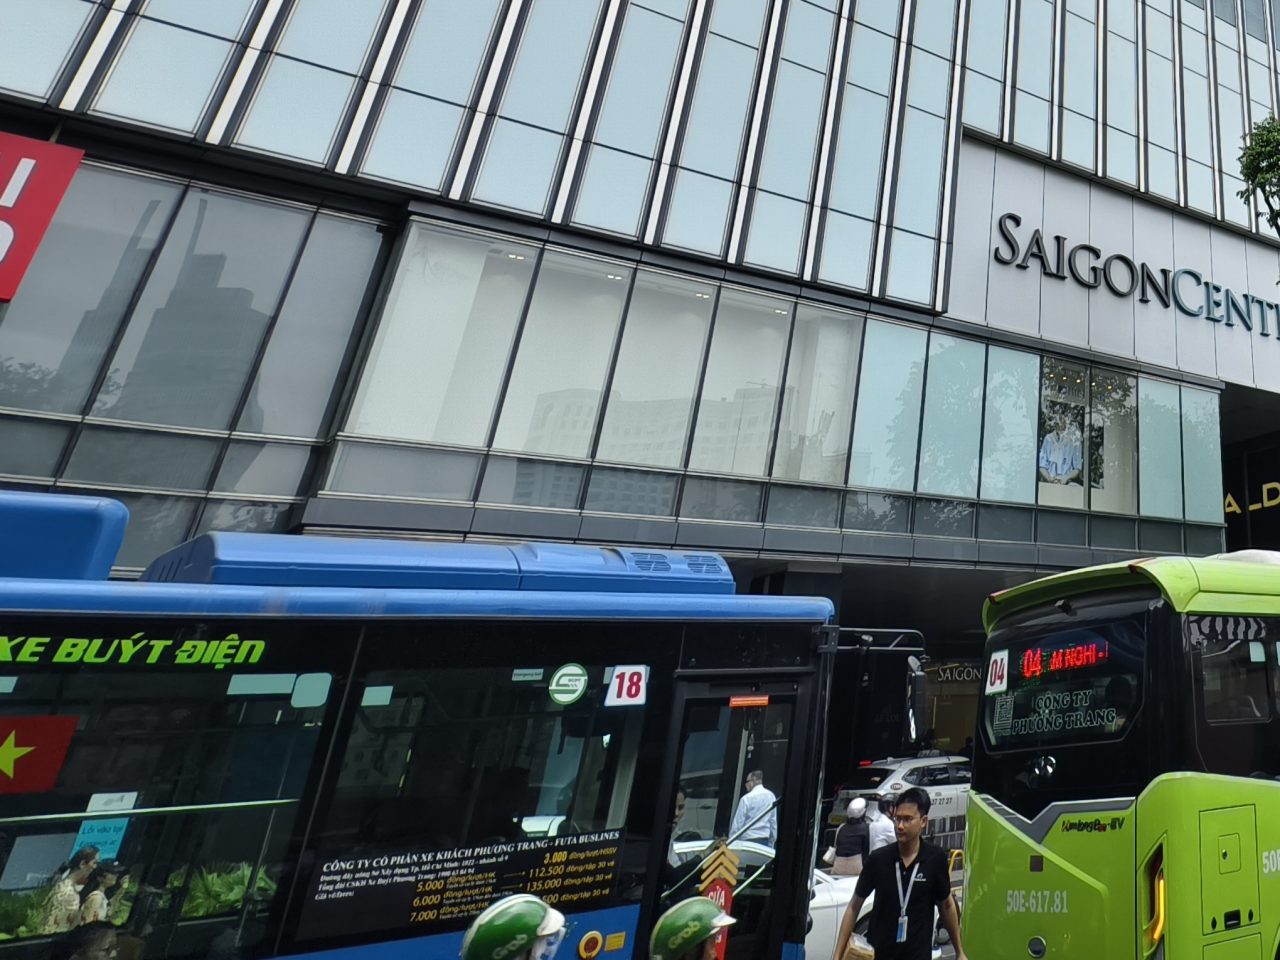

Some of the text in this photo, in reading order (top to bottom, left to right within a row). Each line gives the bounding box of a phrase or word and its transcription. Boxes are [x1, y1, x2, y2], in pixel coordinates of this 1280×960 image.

[52, 632, 174, 664] BUÝT
[174, 633, 266, 669] ĐIỆN
[1022, 648, 1043, 678] 04
[1065, 643, 1097, 667] NGHI
[937, 664, 982, 682] SAIGON
[989, 658, 1006, 687] 04
[615, 671, 643, 699] 18
[1036, 690, 1092, 711] CÔNG TY
[1012, 708, 1117, 734] PHƯƠNG TRANG
[323, 859, 355, 872] CÔNG
[357, 859, 371, 869] TY
[421, 853, 434, 862] XE
[436, 848, 473, 860] KHÁCH
[474, 843, 515, 857] PHƯƠNG
[517, 839, 549, 851] TRANG
[554, 836, 578, 846] FUTA
[579, 831, 620, 844] BUSLINES
[544, 851, 568, 865] 3.000
[529, 863, 564, 878] 112.500
[416, 880, 444, 893] 5.000
[526, 877, 562, 892] 135.000
[413, 894, 441, 907] 6.000
[1006, 890, 1068, 913] 50E-617.81
[409, 909, 437, 922] 7.000
